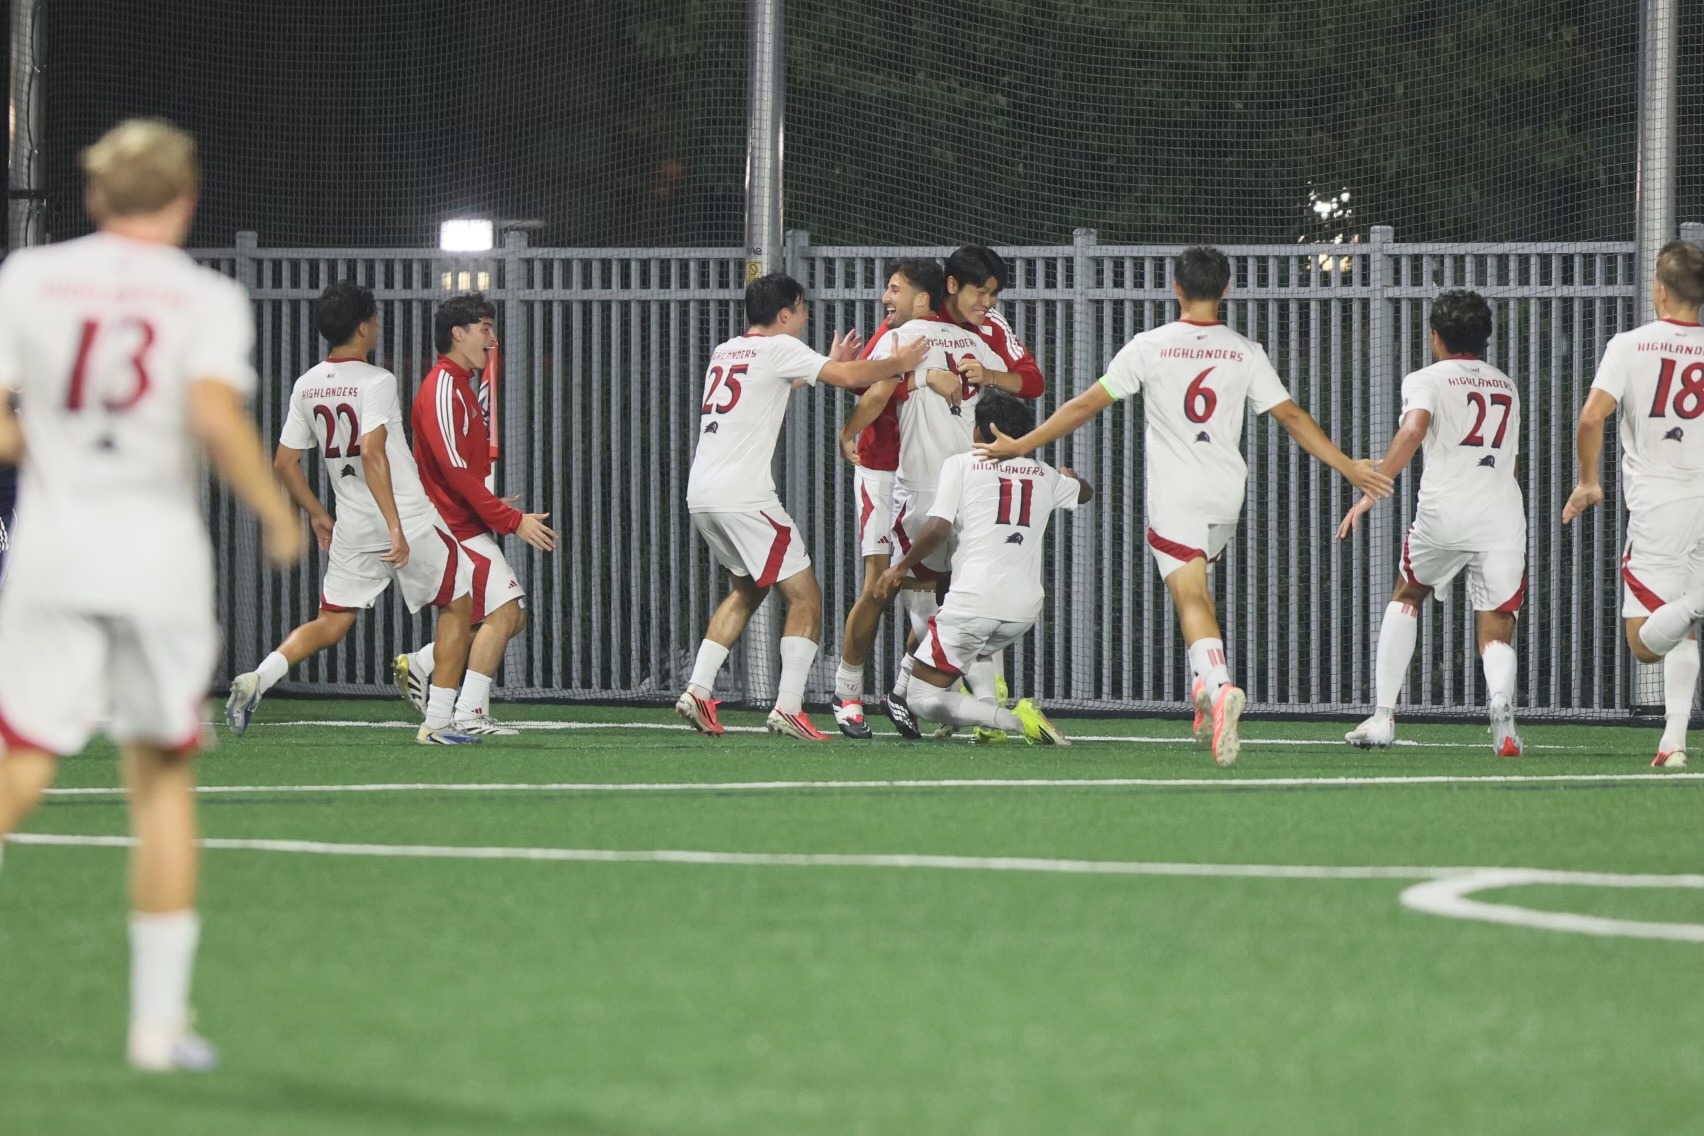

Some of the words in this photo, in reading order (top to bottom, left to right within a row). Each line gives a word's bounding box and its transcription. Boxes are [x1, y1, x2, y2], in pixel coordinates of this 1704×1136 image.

[65, 317, 155, 413] 13
[1160, 347, 1244, 362] HIGHLANDERS
[1638, 342, 1704, 355] HIGHLAND
[302, 387, 358, 400] HIGHLANDERS
[701, 364, 749, 414] 25
[1184, 366, 1217, 423] 6
[1448, 377, 1513, 392] HIGHLANDERS
[1648, 358, 1704, 420] 18
[313, 403, 361, 458] 22
[1459, 392, 1512, 449] 27
[972, 463, 1044, 477] HIGHLANDERS
[995, 477, 1033, 528] 11
